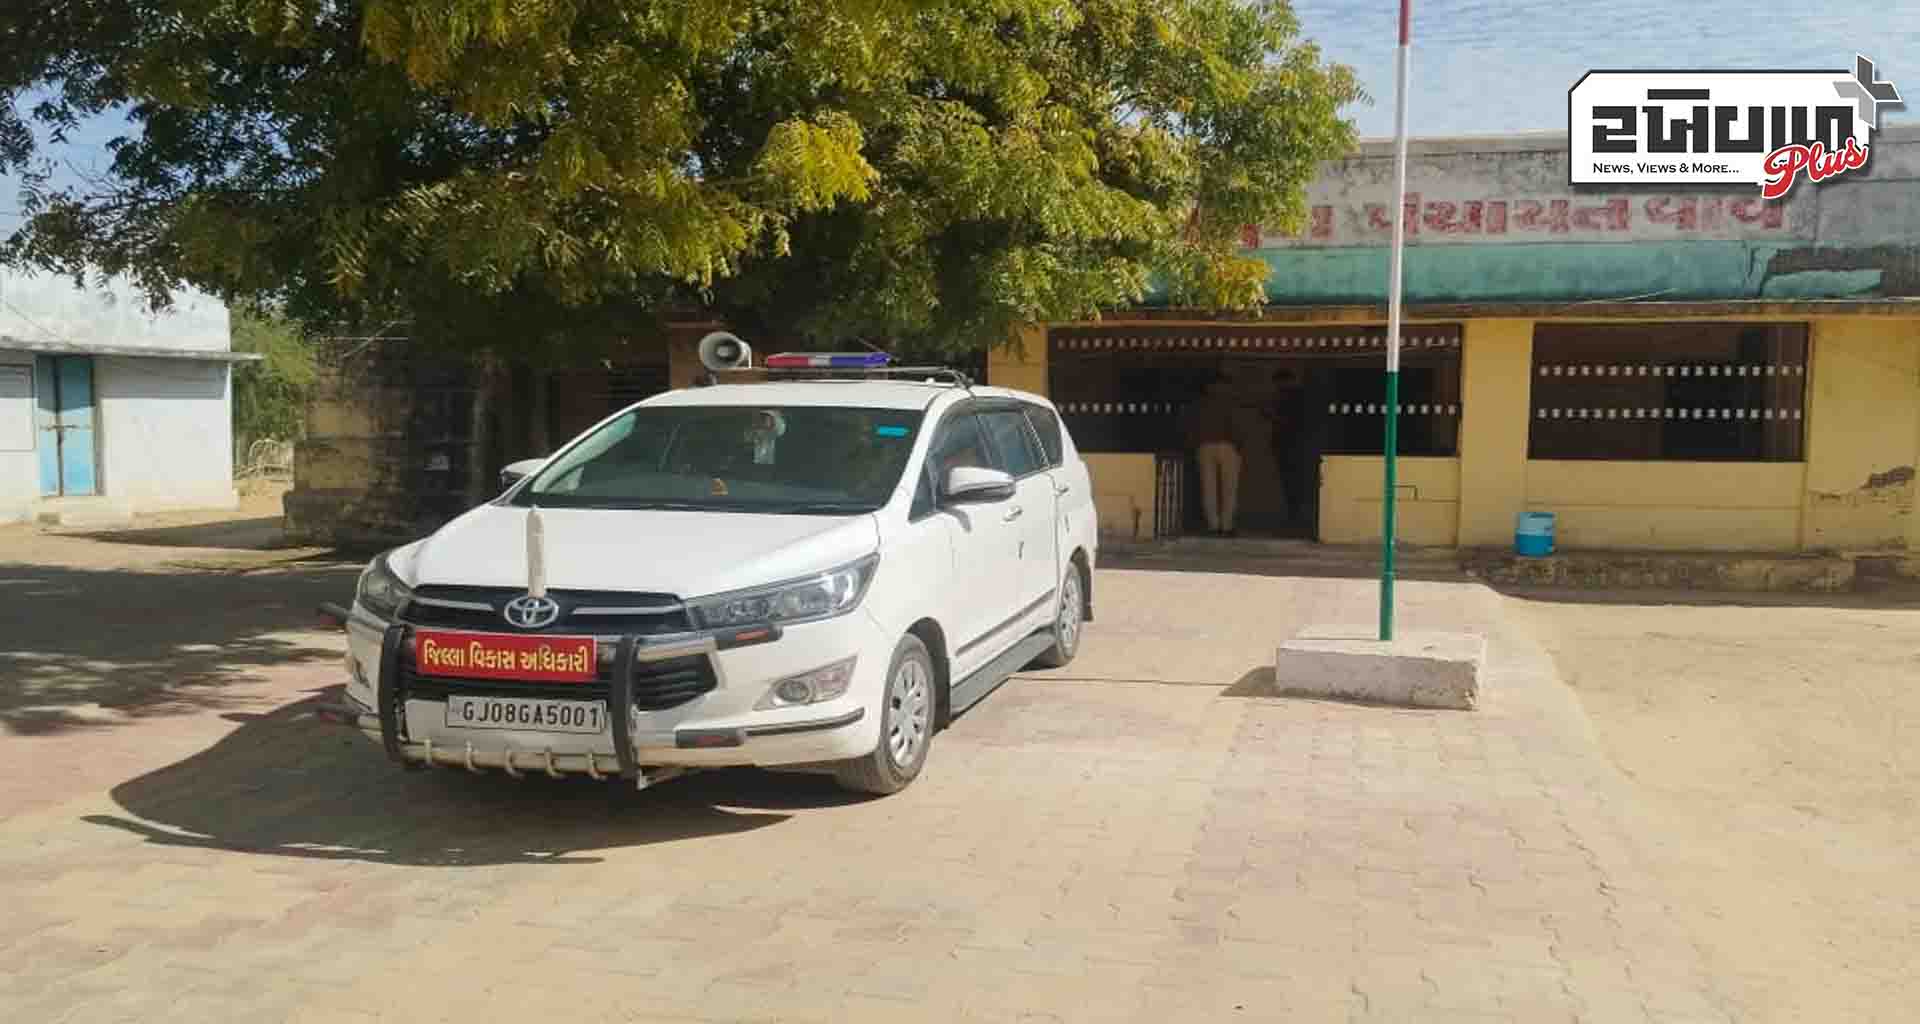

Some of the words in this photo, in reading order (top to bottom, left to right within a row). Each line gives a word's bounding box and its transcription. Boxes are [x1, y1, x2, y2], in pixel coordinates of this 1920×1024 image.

[423, 640, 465, 667] જિલ્લા
[469, 641, 516, 670] વિકાસ
[519, 645, 589, 673] અધિકારી
[463, 702, 600, 727] GJ08GA5001
